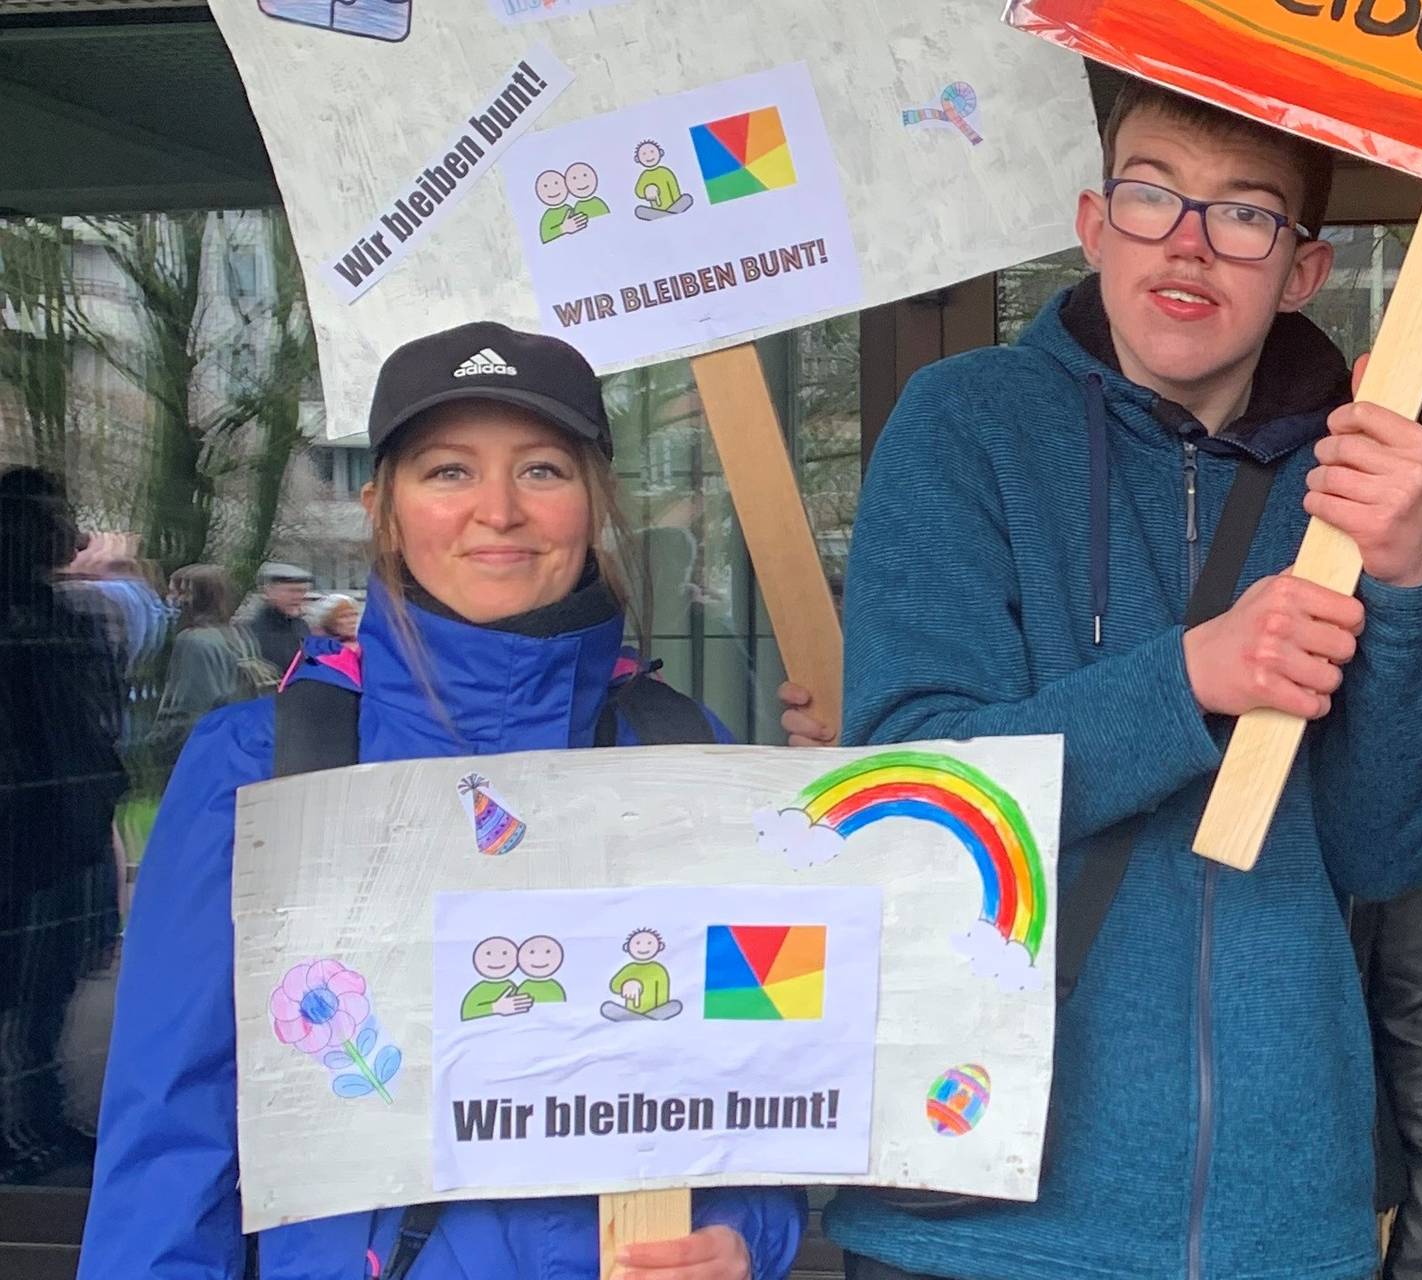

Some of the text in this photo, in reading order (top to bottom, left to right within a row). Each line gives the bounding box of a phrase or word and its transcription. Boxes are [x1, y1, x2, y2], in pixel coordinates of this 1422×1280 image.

[333, 230, 392, 288] Wir
[380, 134, 486, 243] bleiben
[468, 60, 548, 146] bunt!
[553, 238, 828, 327] WIR BLEIBEN BUNT!
[453, 364, 518, 378] adidas
[452, 1089, 840, 1141] Wir bleiben bunt!
